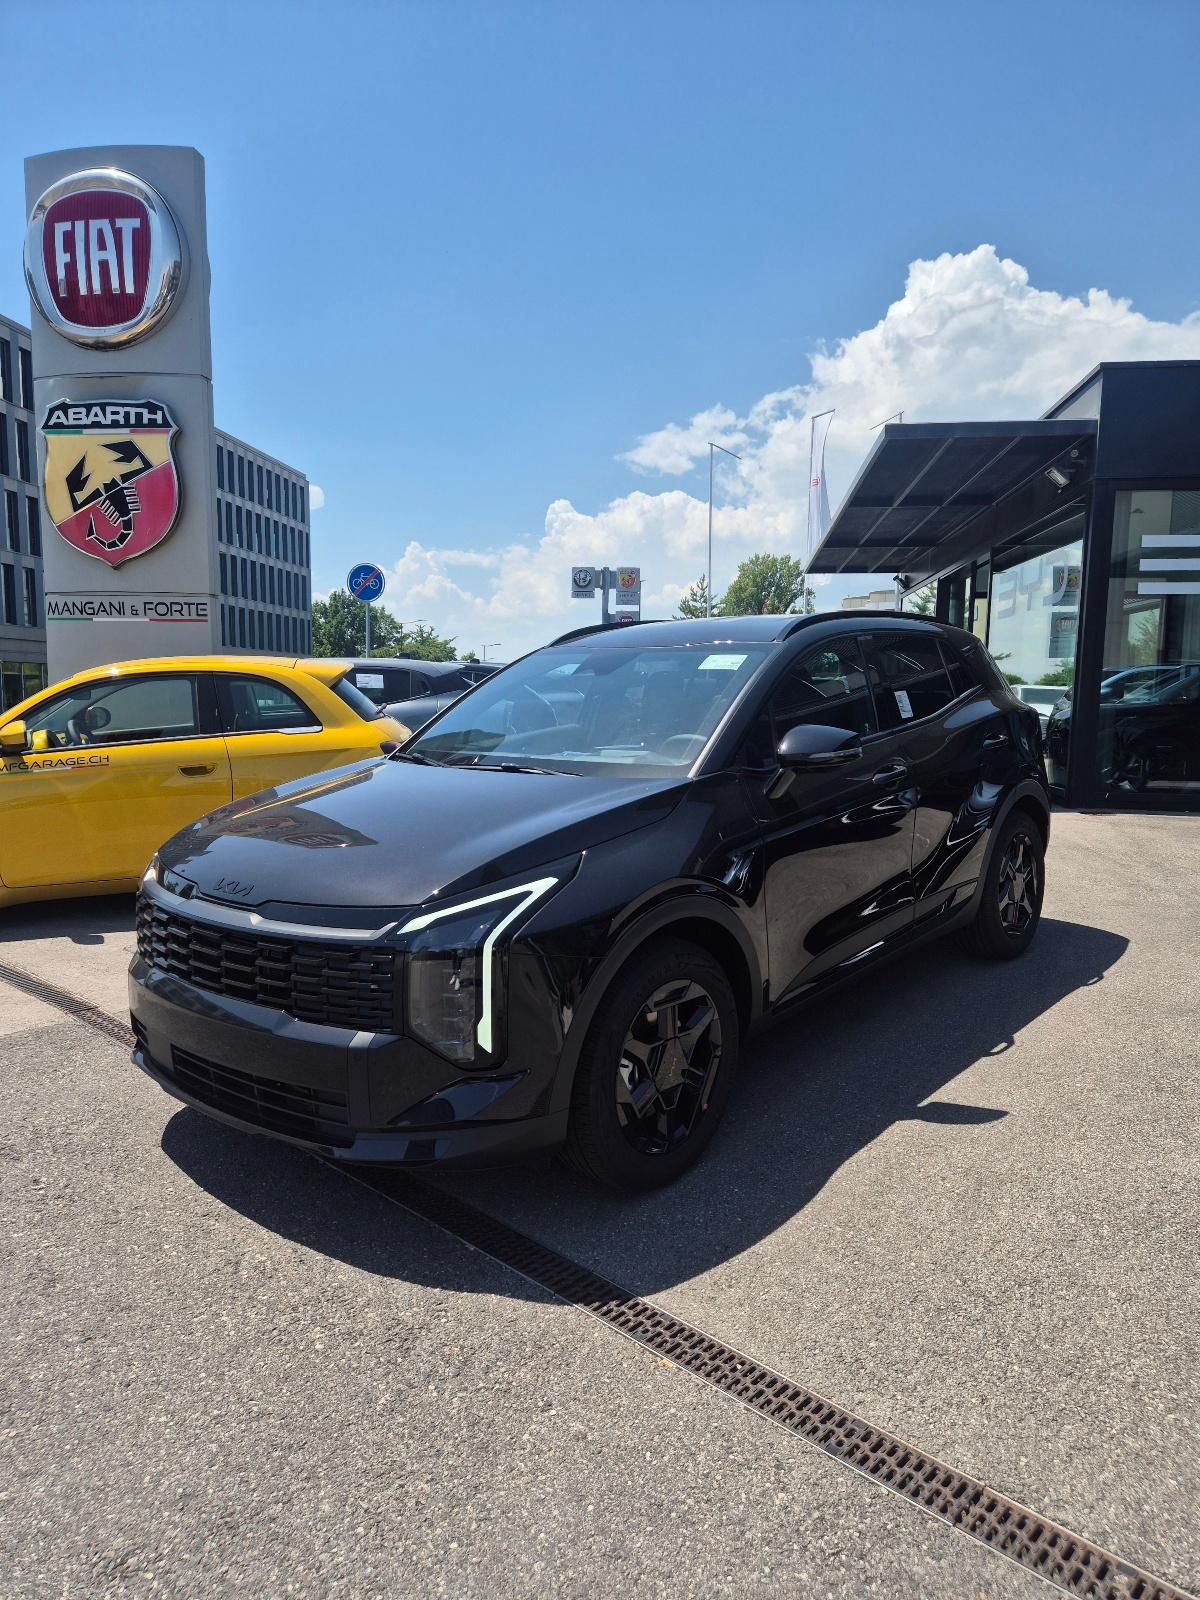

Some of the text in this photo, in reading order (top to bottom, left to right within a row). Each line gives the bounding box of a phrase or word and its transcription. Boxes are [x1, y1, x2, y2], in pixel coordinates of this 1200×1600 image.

[54, 217, 141, 297] FIAT
[48, 405, 163, 425] ABARTH
[47, 600, 209, 617] MANGANI & FORTE
[213, 877, 256, 897] KIA
